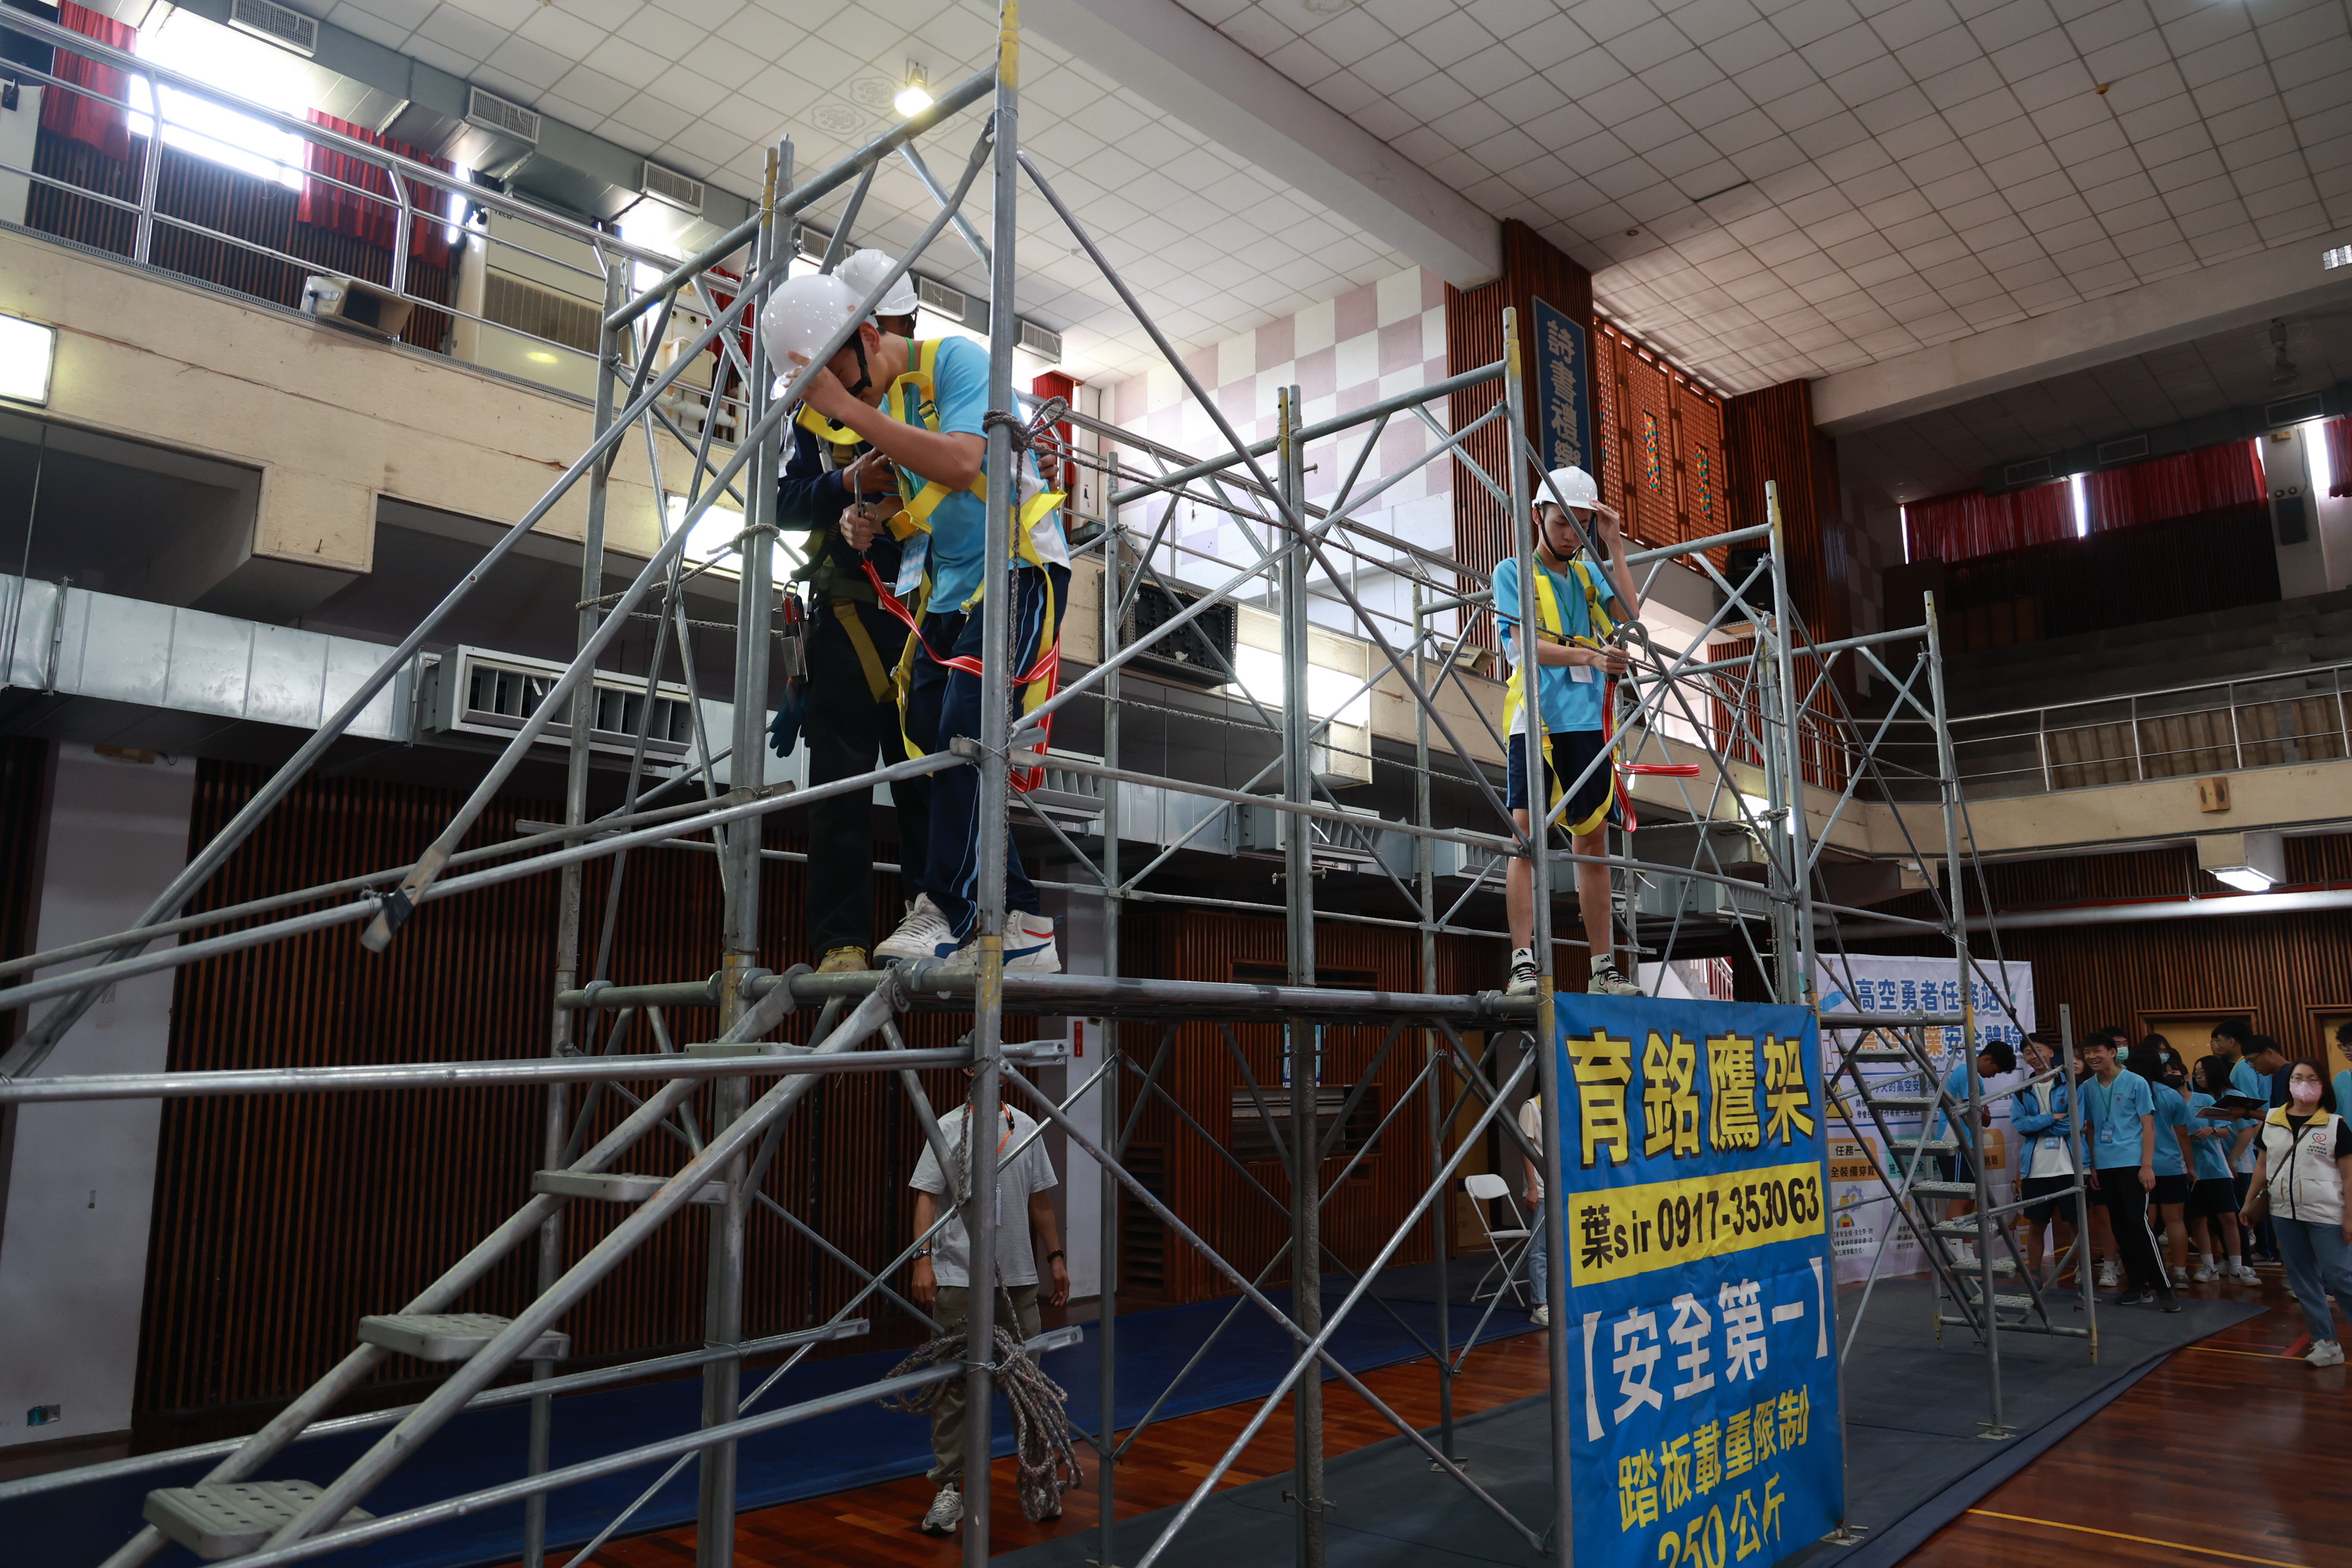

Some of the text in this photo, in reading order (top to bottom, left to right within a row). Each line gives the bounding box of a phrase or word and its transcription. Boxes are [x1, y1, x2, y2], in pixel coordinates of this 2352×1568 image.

[1565, 1026, 1816, 1170] 育銘鷹架
[1835, 1145, 1862, 1157] 任務一
[1656, 1175, 1820, 1253] 0917-353063
[1618, 1384, 1810, 1533] 踏板載重限制
